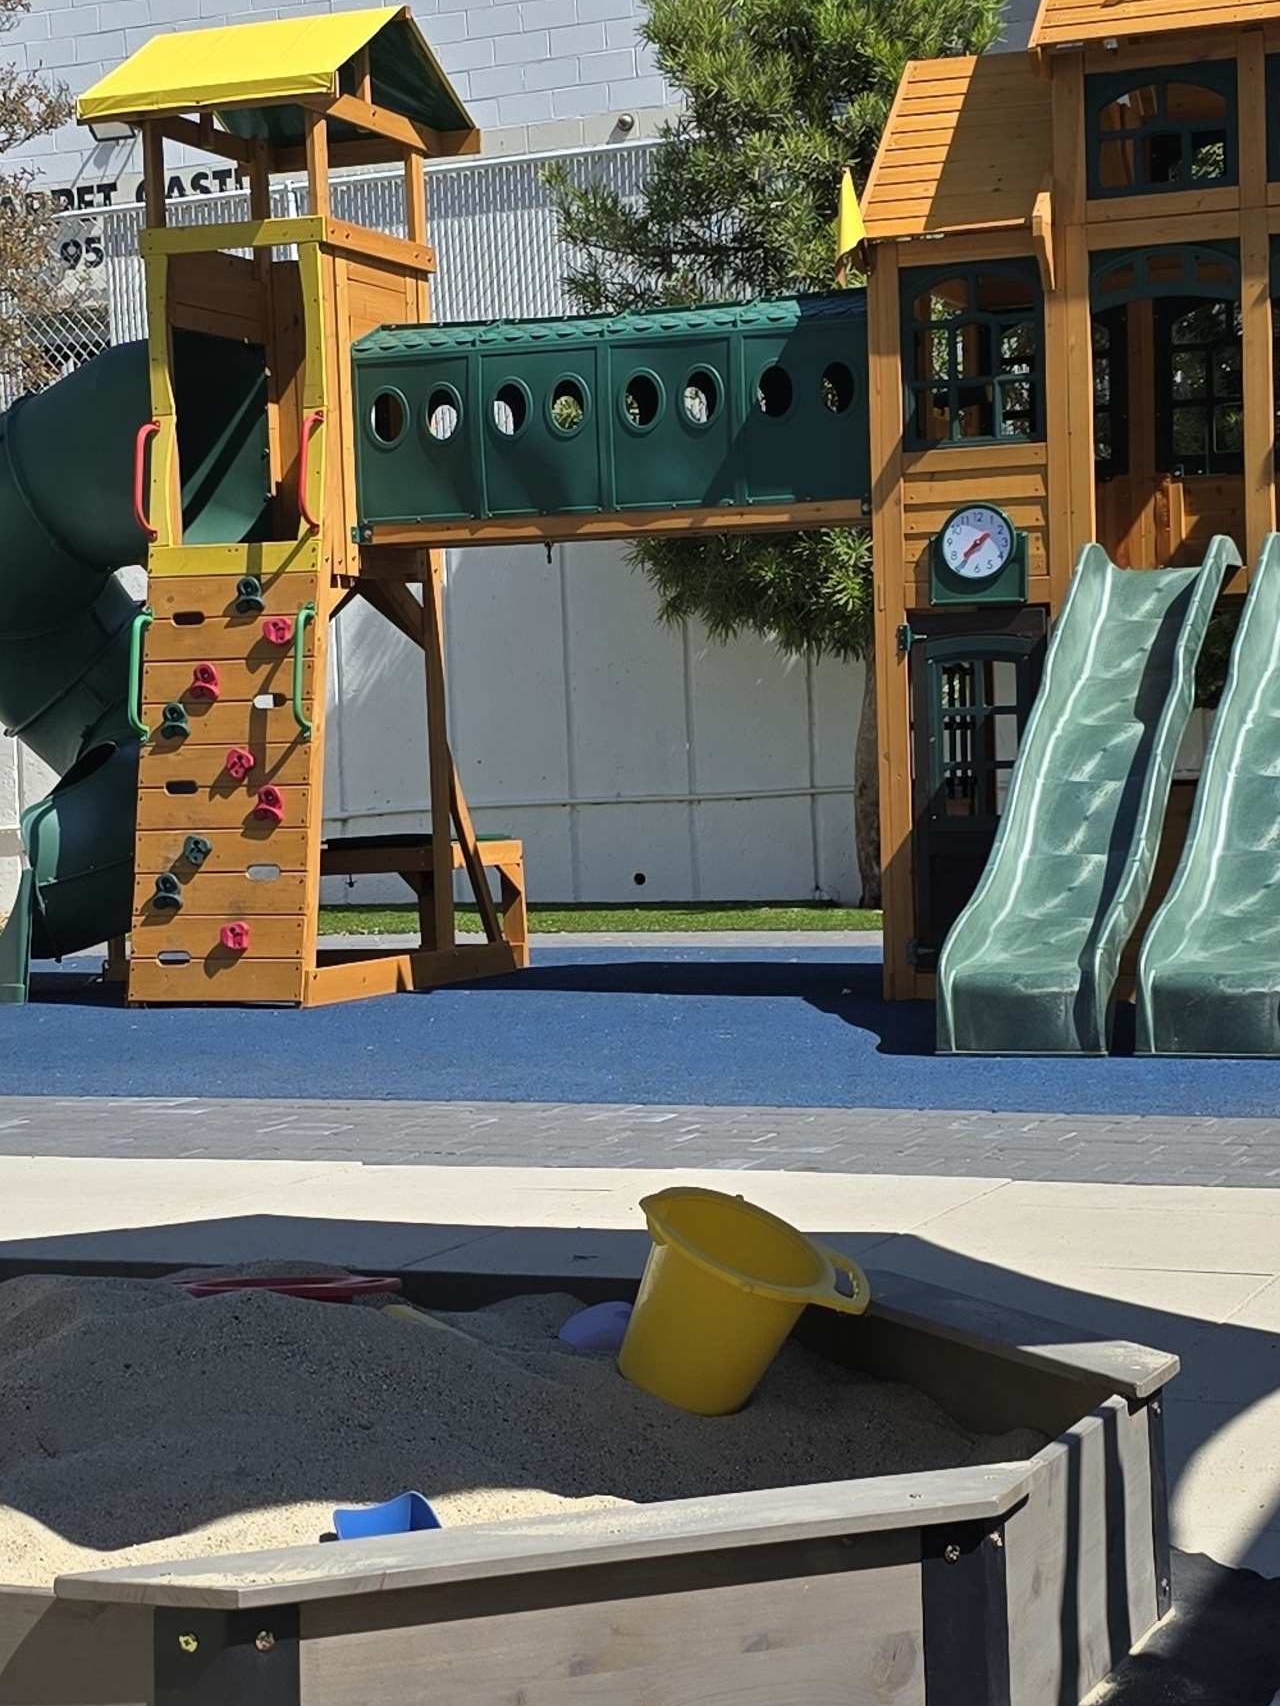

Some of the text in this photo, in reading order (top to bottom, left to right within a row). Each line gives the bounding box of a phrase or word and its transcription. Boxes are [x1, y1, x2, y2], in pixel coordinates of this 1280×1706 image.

[961, 515, 969, 525] 11
[974, 512, 984, 522] 12
[1001, 537, 1008, 548] 3
